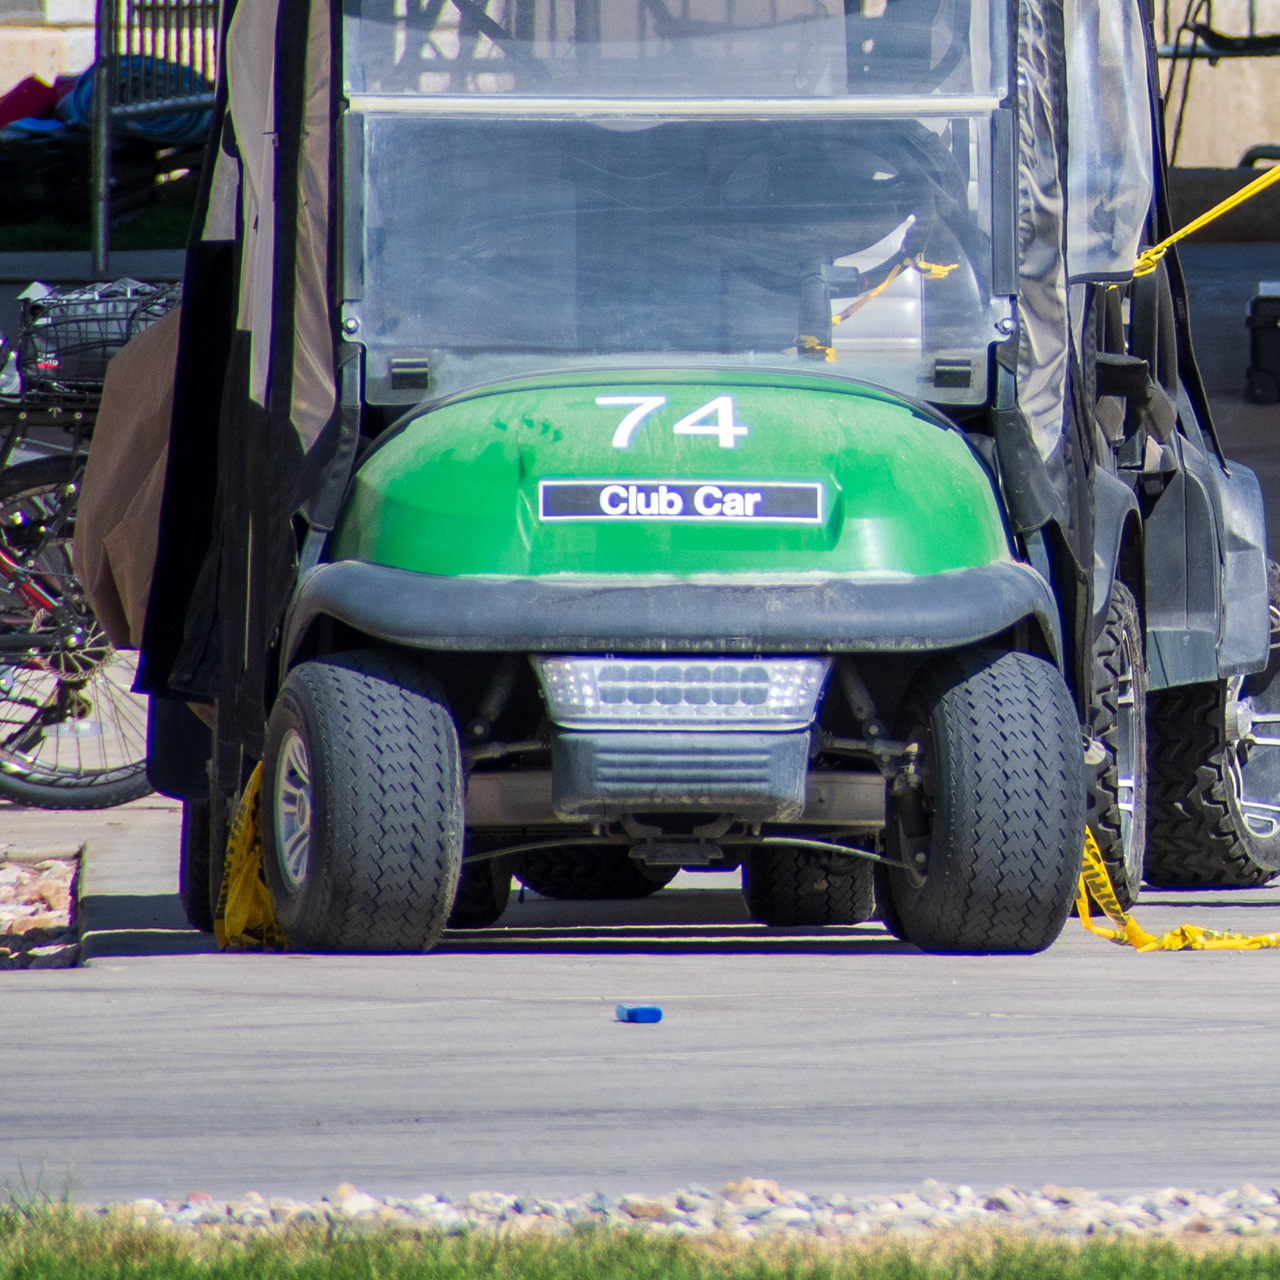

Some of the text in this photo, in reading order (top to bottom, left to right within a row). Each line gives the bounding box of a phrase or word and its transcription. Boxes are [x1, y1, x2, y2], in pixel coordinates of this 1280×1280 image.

[595, 396, 748, 448] 74
[600, 484, 761, 516] Club Car
